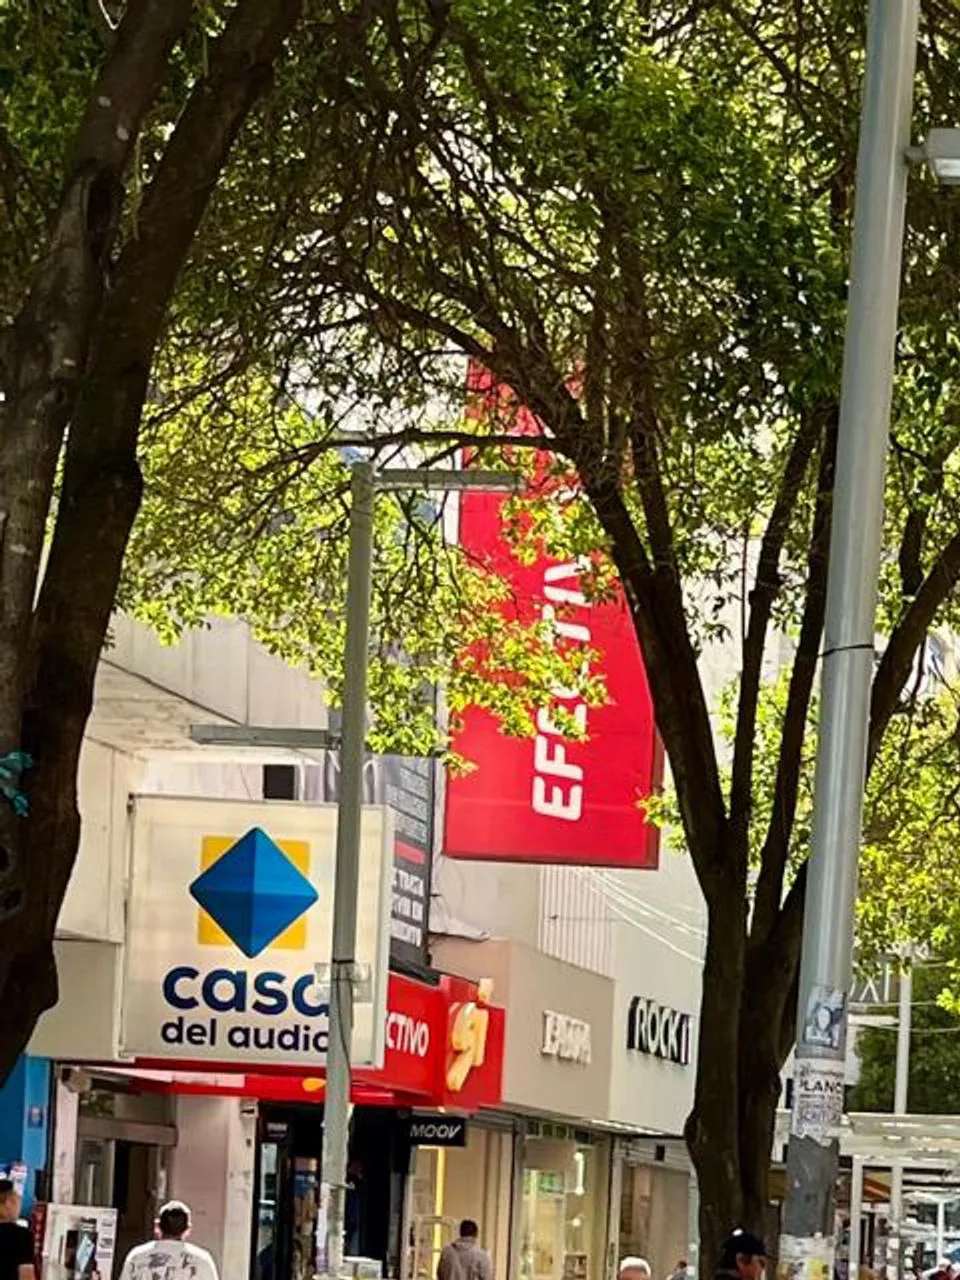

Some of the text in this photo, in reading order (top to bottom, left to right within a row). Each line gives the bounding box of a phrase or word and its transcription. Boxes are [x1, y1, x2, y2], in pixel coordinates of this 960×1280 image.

[162, 965, 331, 1016] casa
[160, 1016, 331, 1053] del audio
[410, 1123, 462, 1139] MOOV
